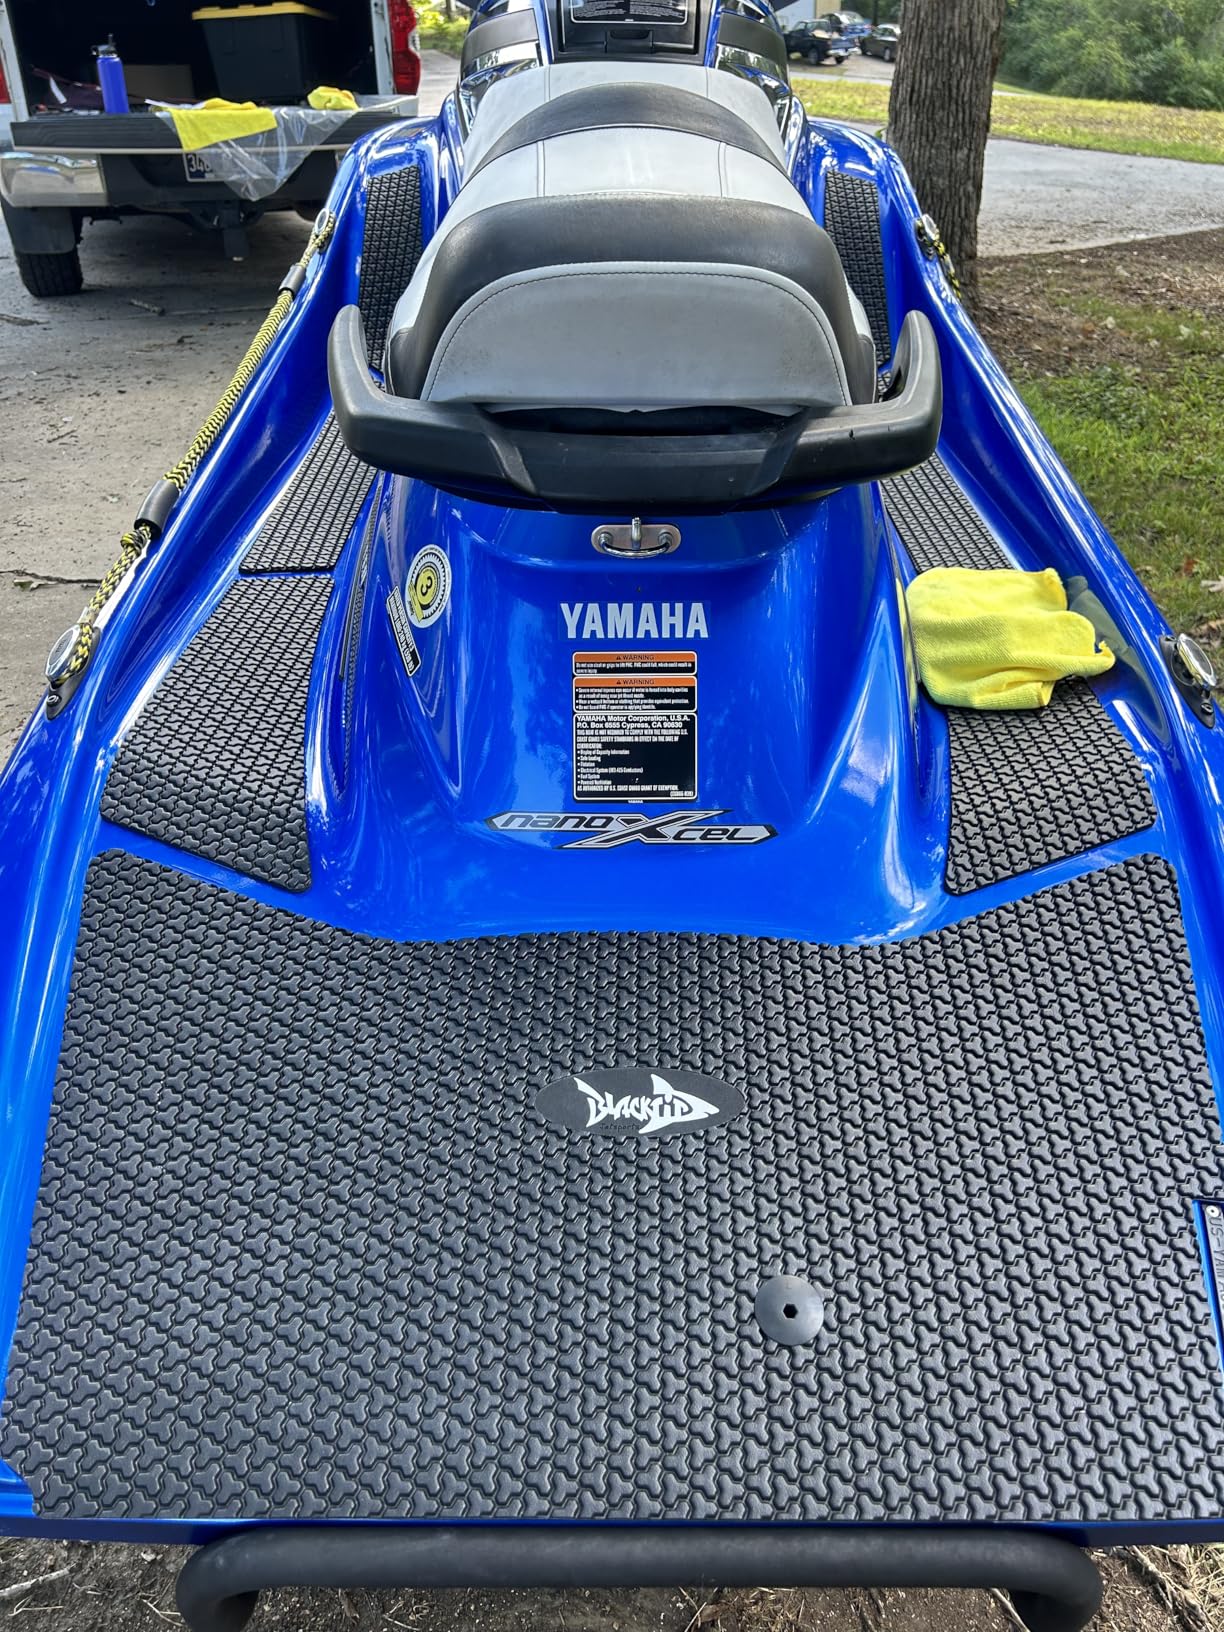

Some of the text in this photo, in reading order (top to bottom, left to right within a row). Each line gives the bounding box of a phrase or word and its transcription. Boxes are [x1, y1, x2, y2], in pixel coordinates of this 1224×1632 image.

[560, 603, 709, 639] YAMAHA
[628, 715, 669, 723] Corporation,
[621, 722, 651, 730] Cypress,
